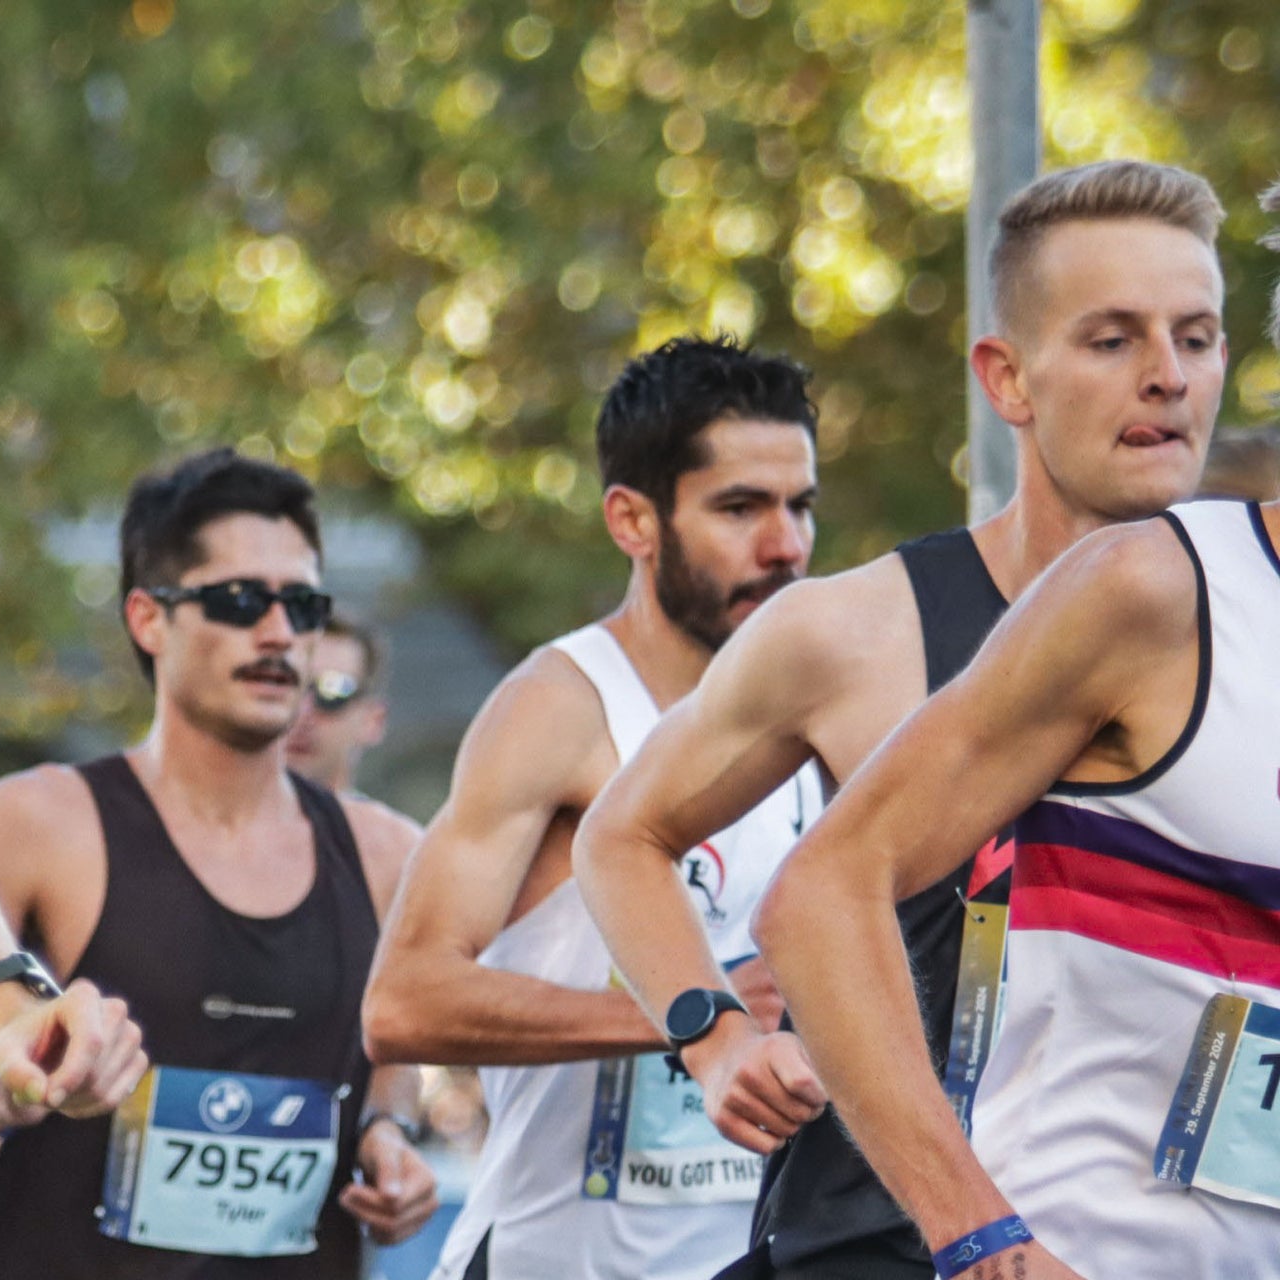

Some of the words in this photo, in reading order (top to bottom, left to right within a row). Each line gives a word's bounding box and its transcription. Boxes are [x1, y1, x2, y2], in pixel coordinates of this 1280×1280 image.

[1208, 1030, 1226, 1061] 2024
[1190, 1059, 1218, 1118] September
[1185, 1118, 1199, 1136] 29.
[165, 1139, 319, 1194] 79547
[628, 1161, 672, 1187] YOU
[680, 1160, 715, 1186] GOT
